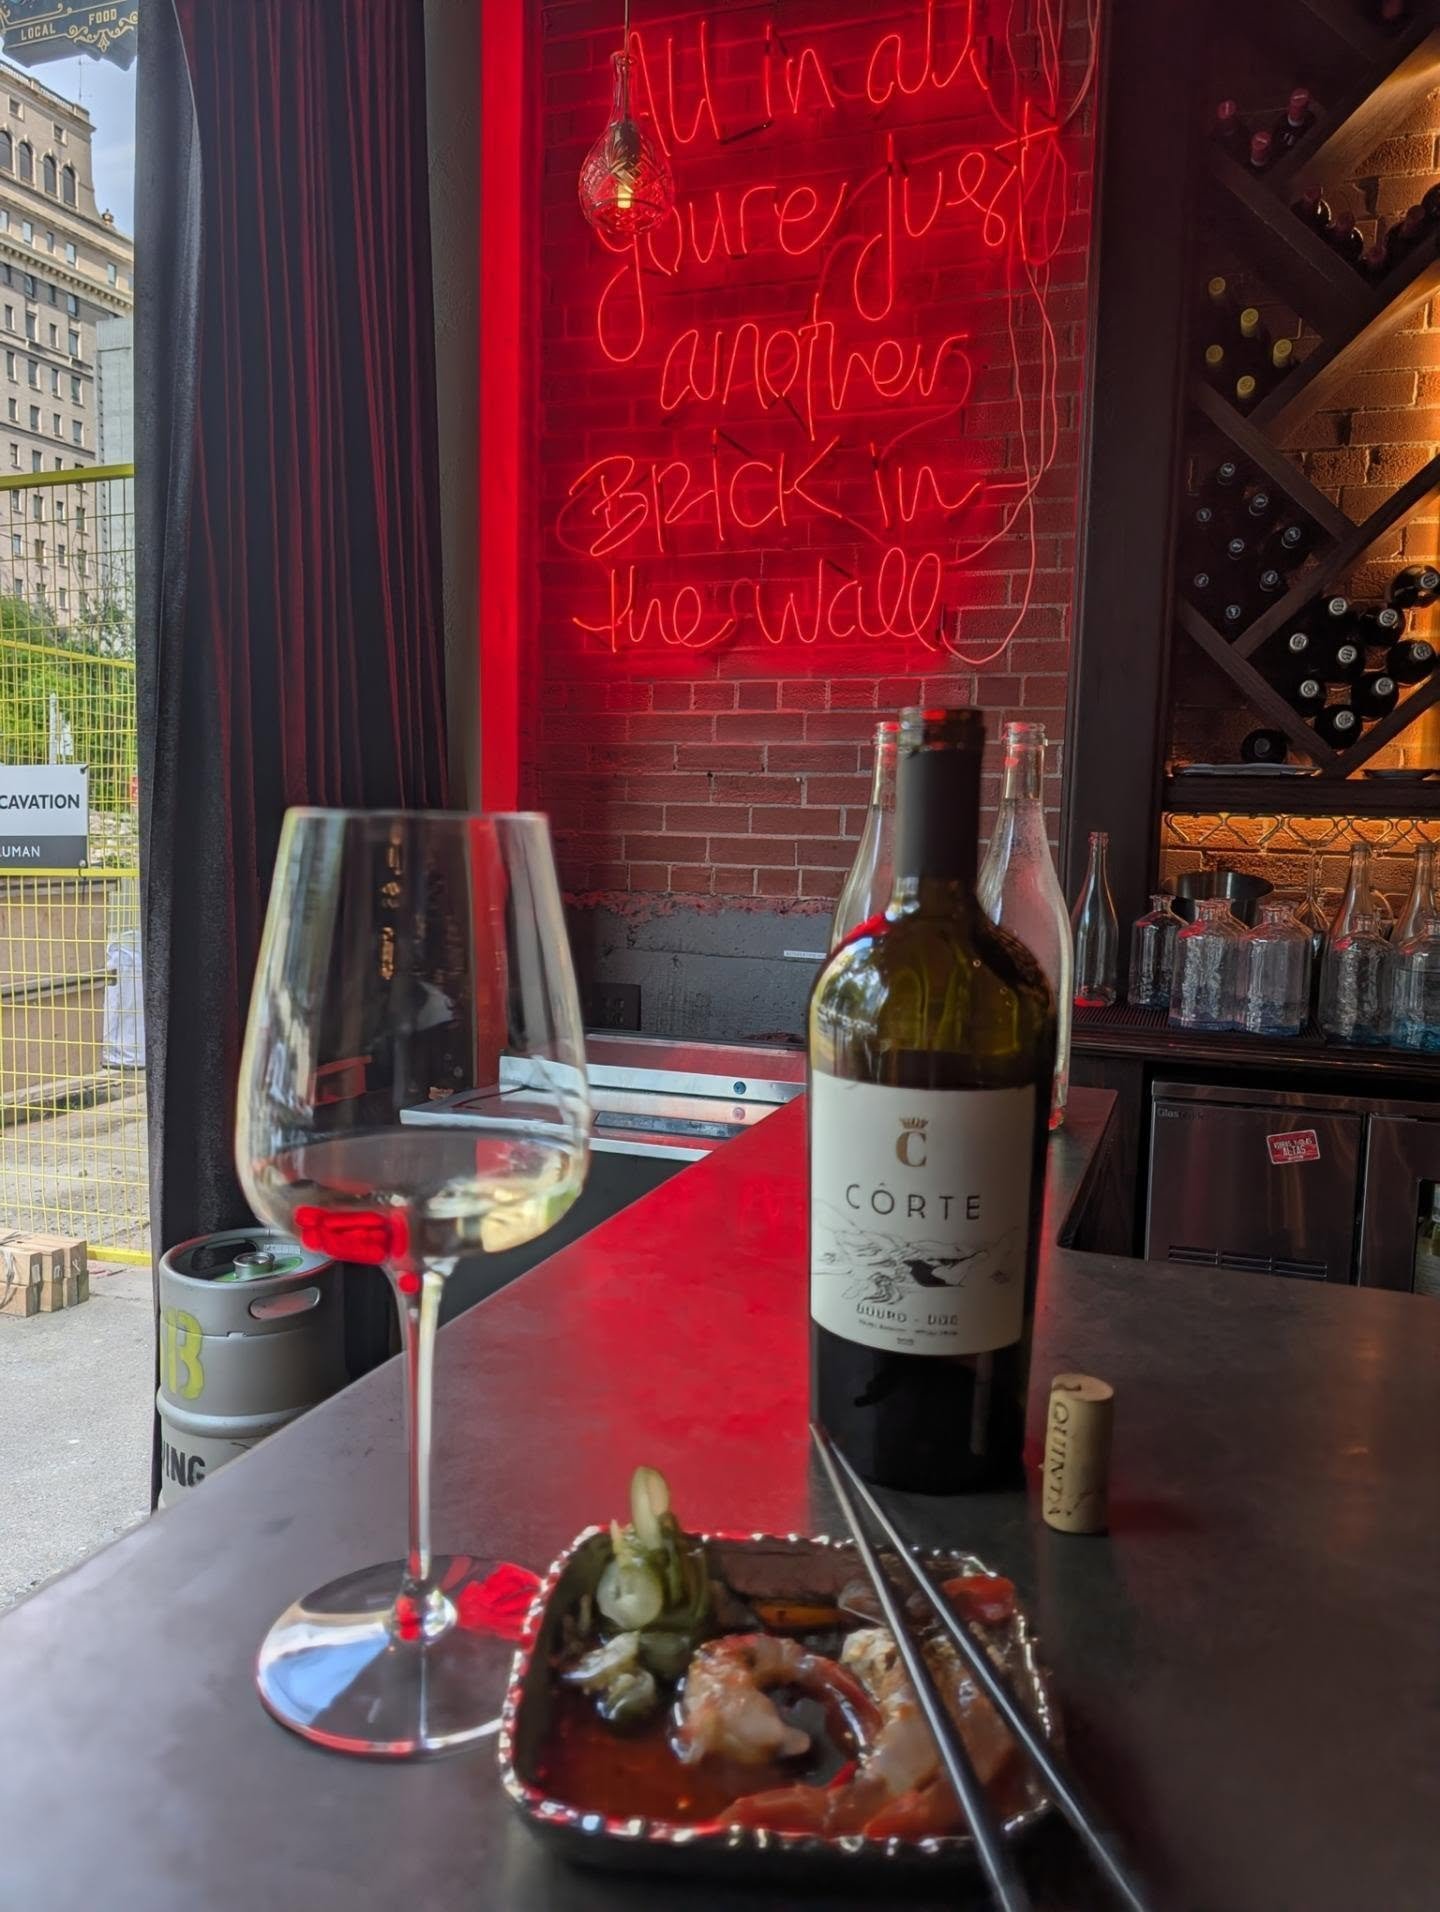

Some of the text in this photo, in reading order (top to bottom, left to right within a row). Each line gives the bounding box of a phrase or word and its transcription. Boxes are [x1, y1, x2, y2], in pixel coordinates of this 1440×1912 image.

[20, 8, 118, 41] LOCAL FOOD
[764, 23, 836, 118] in
[867, 0, 989, 104] all
[853, 100, 1060, 322] just
[659, 292, 970, 442] another
[869, 441, 982, 528] in
[572, 546, 938, 653] the wall
[0, 794, 80, 809] CAVATION
[0, 846, 41, 857] UMAN
[895, 1130, 928, 1168] C
